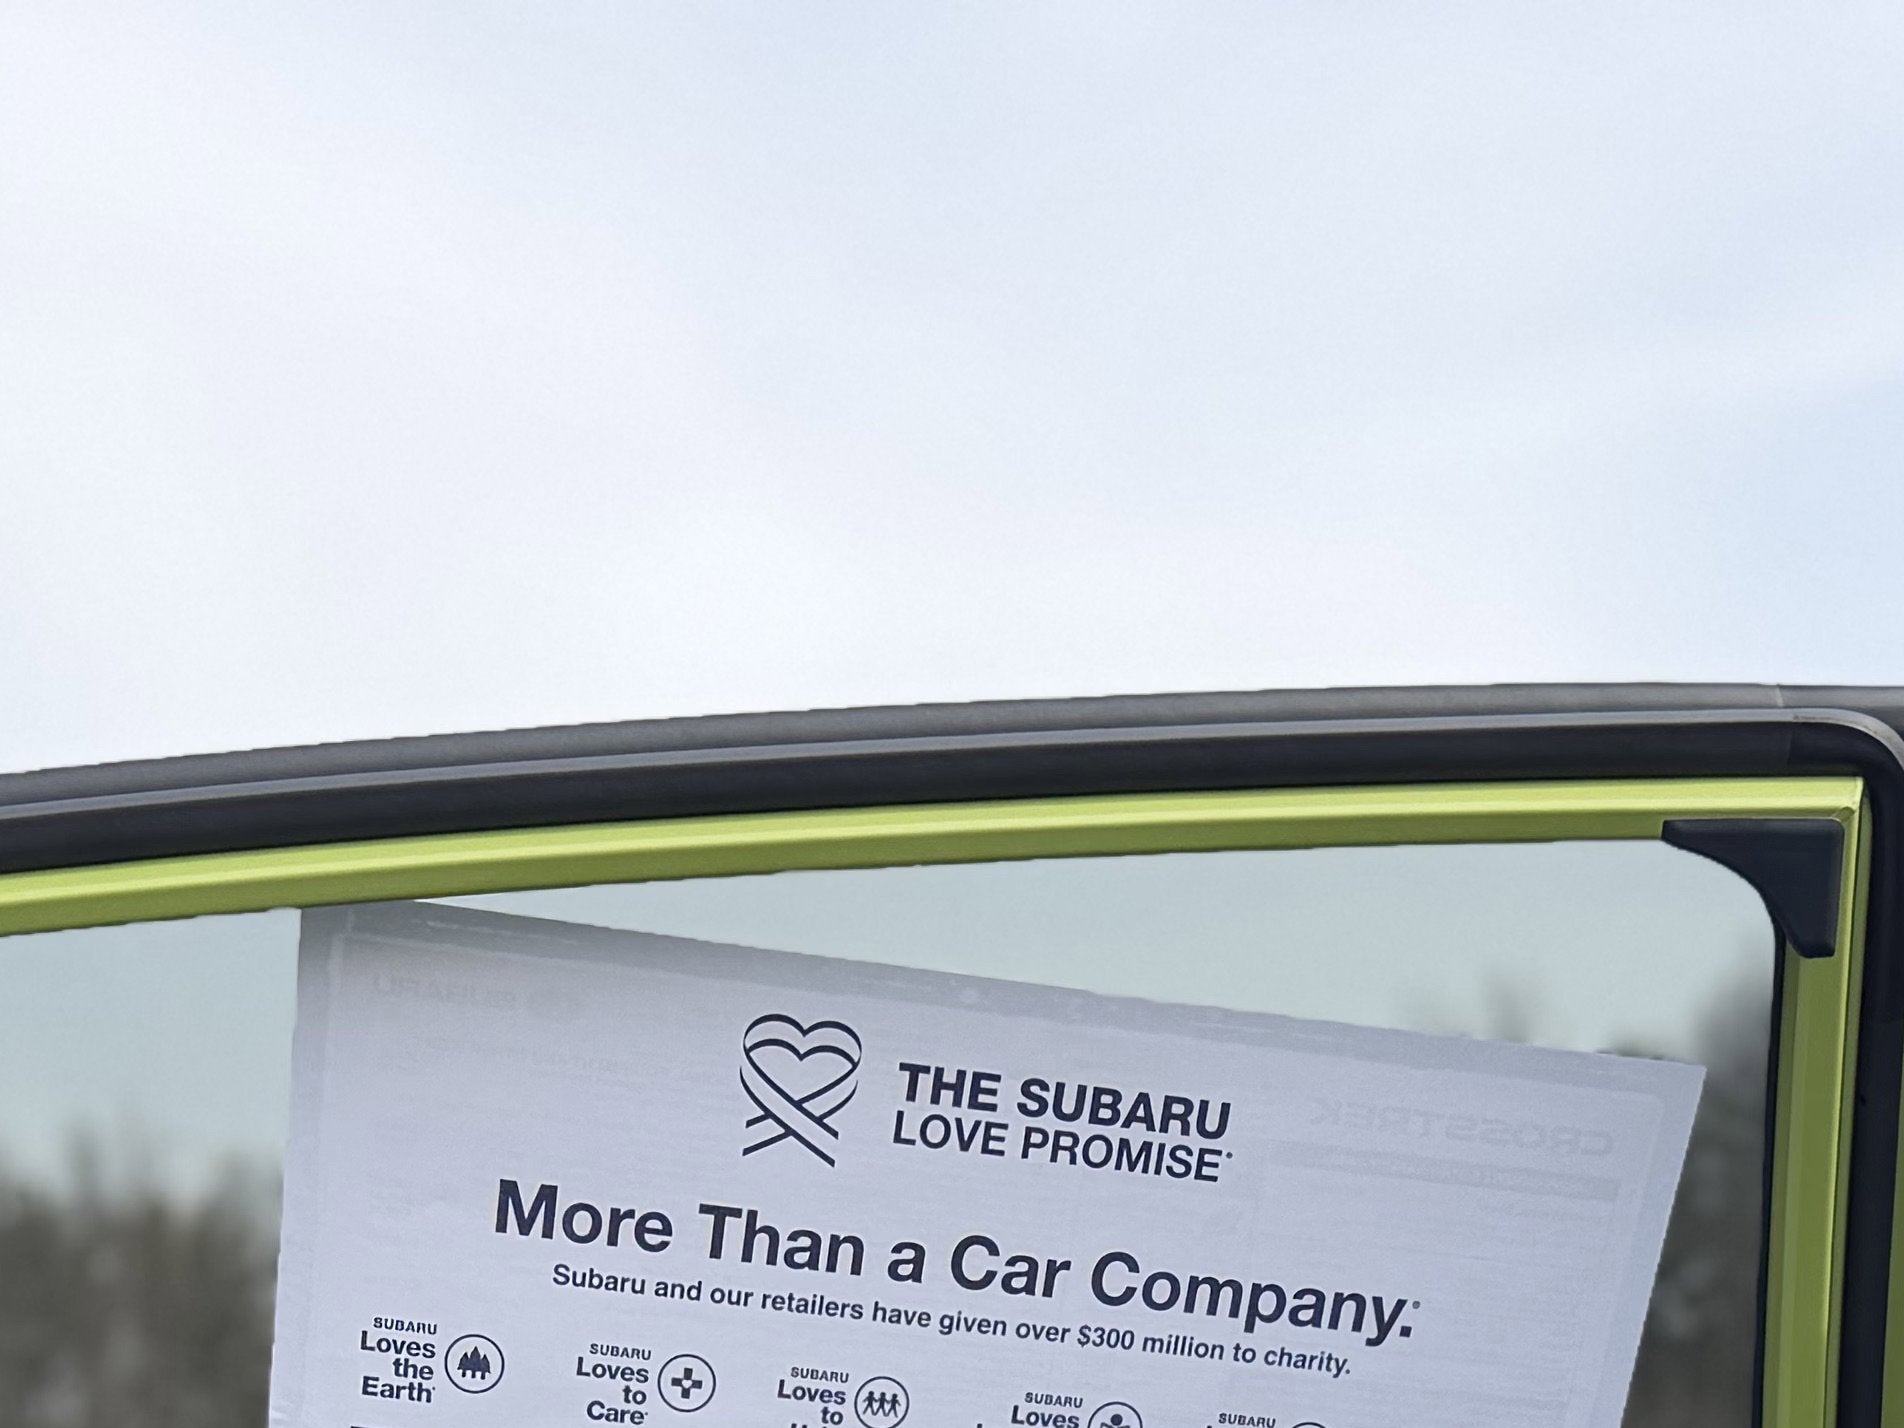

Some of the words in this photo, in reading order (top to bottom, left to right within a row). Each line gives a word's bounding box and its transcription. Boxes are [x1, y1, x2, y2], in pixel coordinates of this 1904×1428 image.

[899, 1062, 1001, 1112] THE
[1017, 1078, 1231, 1139] SUBARU
[893, 1110, 1009, 1157] LOVE
[495, 1179, 673, 1253] More
[698, 1203, 864, 1276] Than
[888, 1242, 925, 1284] a
[951, 1235, 1071, 1298] Car
[373, 1317, 437, 1335] SUBARU
[553, 1264, 646, 1295] Subaru
[654, 1281, 702, 1301] and
[710, 1288, 754, 1307] our
[761, 1292, 864, 1320] retailers
[872, 1301, 931, 1328] have
[938, 1310, 1007, 1336] given
[1015, 1323, 1071, 1343] over
[1077, 1324, 1135, 1350] $300
[1142, 1334, 1224, 1360] million
[1233, 1343, 1256, 1363] to
[1264, 1347, 1350, 1378] charity.
[361, 1330, 436, 1358] Loves
[589, 1343, 651, 1360] SUBARU
[392, 1358, 434, 1380] the
[576, 1356, 649, 1383] Loves
[791, 1367, 849, 1383] SUBARU
[622, 1385, 647, 1405] to
[777, 1379, 846, 1405] Loves
[1025, 1392, 1083, 1408] SUBARU
[821, 1406, 843, 1425] to
[1218, 1413, 1276, 1428] SUBARU
